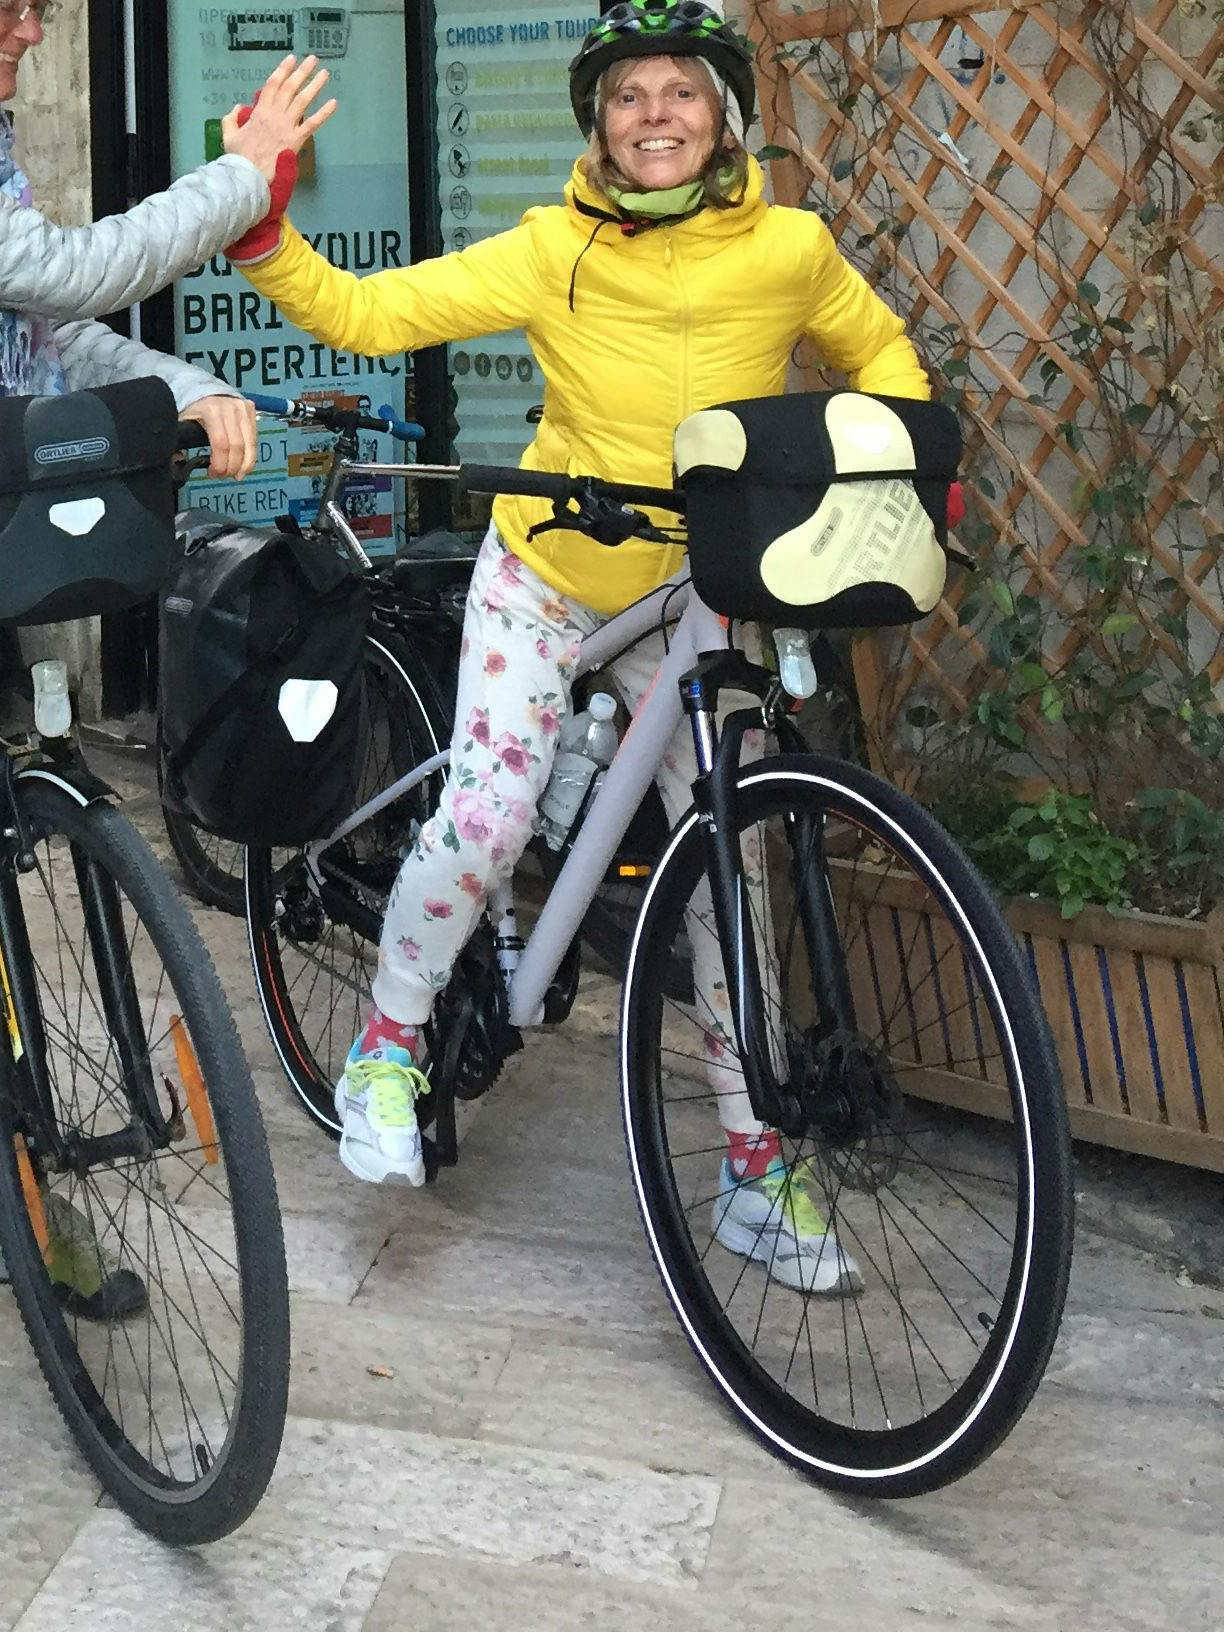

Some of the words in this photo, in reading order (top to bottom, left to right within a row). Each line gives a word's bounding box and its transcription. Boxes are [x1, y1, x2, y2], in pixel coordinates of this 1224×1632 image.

[446, 25, 504, 48] CHOOSE
[508, 21, 550, 43] YOUR
[183, 291, 283, 335] BARI
